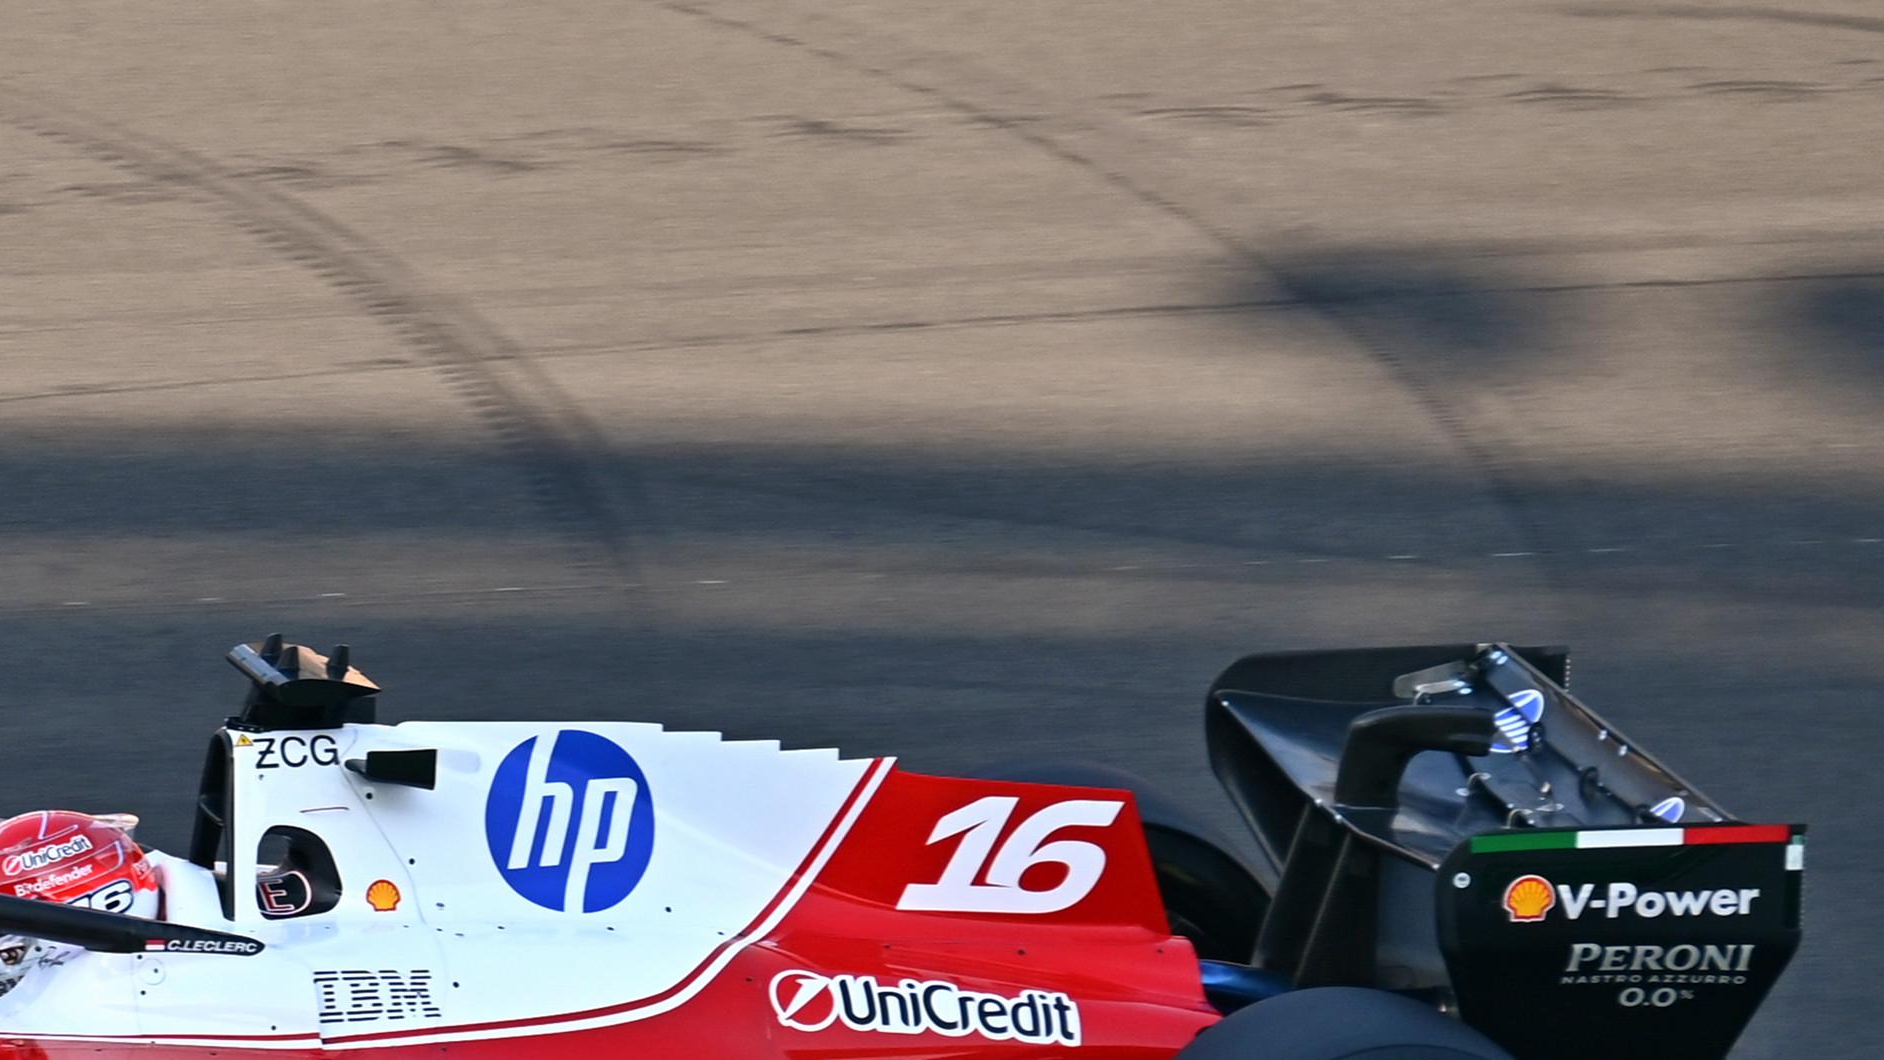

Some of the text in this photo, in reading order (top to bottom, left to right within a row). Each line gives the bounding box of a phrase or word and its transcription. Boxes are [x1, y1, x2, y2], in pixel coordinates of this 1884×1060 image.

[252, 734, 340, 769] ZCG
[506, 729, 639, 914] hp
[21, 836, 91, 870] UniCredit
[895, 795, 1125, 914] 16
[14, 863, 93, 898] Bitdefender
[1556, 882, 1761, 920] V-Power
[167, 939, 258, 953] C.LECLERC
[1565, 942, 1756, 972] PERONI
[312, 968, 443, 1024] IBM
[1560, 974, 1747, 985] NASTRO AZZURRO
[838, 977, 1076, 1041] UniCredit
